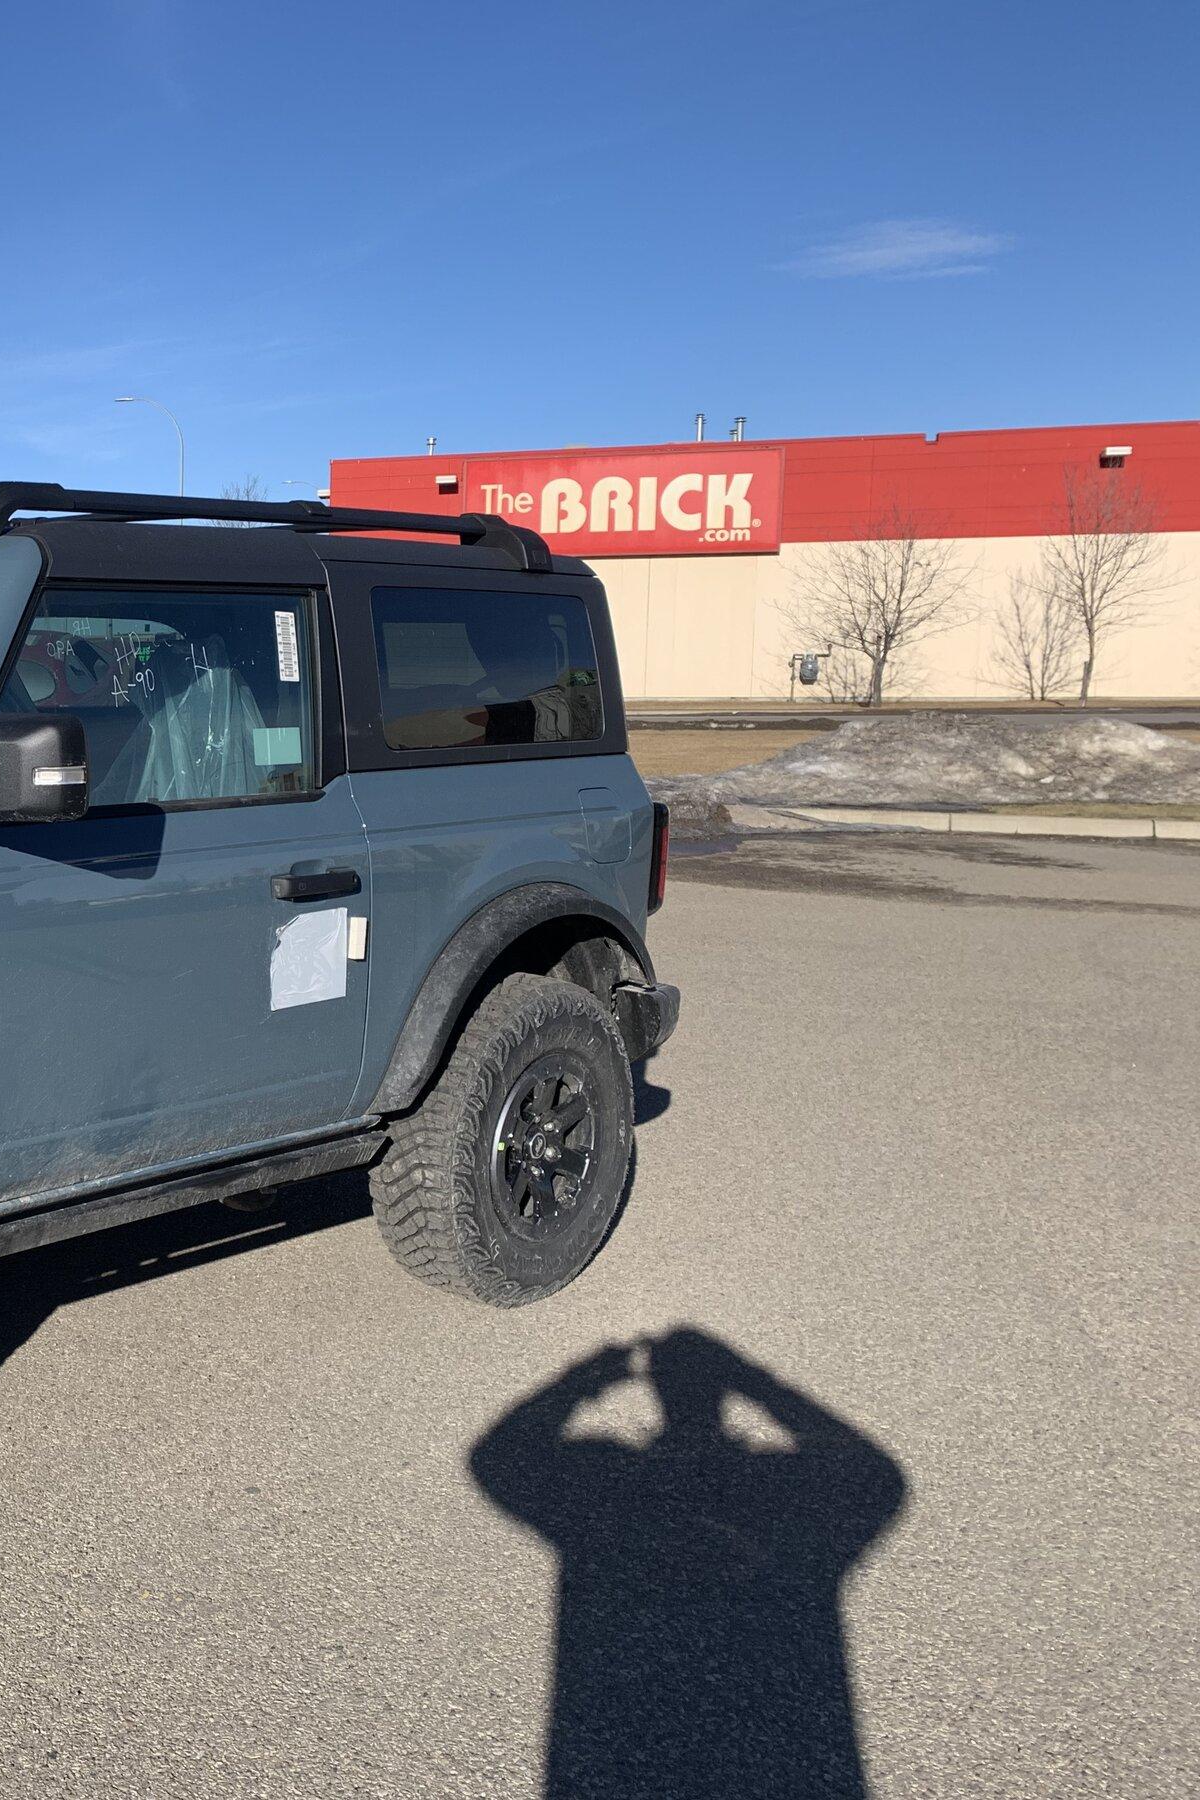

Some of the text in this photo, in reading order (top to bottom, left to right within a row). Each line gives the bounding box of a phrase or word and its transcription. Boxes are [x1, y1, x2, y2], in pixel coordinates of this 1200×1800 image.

[480, 473, 754, 534] The BRICK
[697, 528, 751, 542] .com
